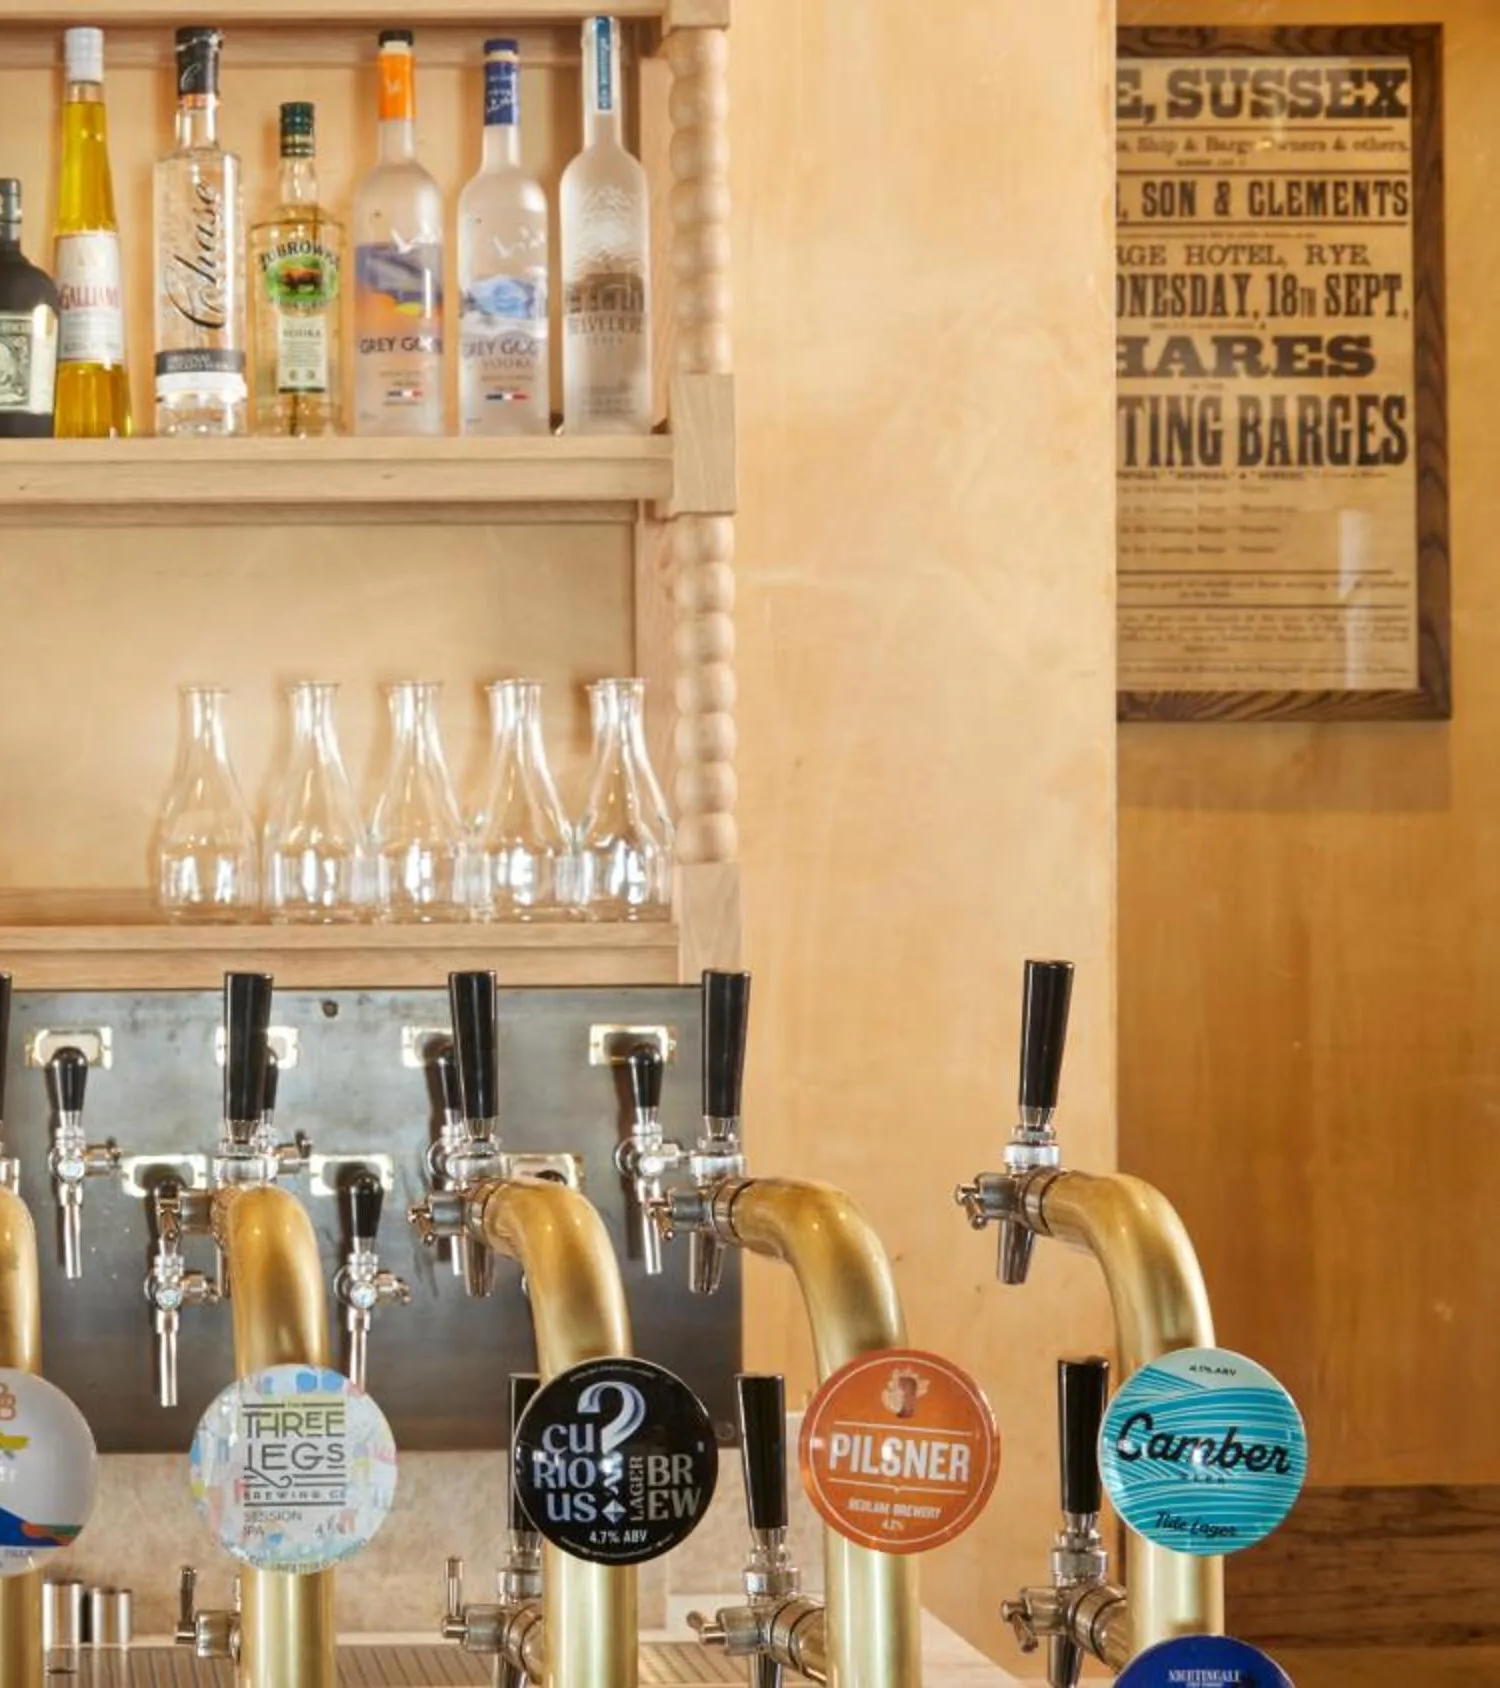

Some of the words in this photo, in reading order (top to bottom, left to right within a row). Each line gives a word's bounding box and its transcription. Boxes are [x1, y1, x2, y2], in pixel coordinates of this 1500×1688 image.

[1167, 68, 1408, 120] SUSSEX
[1142, 180, 1197, 218] SON
[1214, 180, 1232, 218] &
[1248, 180, 1409, 218] CLEMENTS
[164, 181, 227, 331] Chase
[1117, 394, 1223, 467] TING
[1237, 394, 1409, 467] BARGES
[243, 1411, 346, 1439] THREE
[1117, 1412, 1291, 1474] Camber
[243, 1442, 346, 1482] LEGS
[829, 1432, 971, 1483] PILSNER
[629, 1455, 645, 1522] LAGER
[892, 1502, 942, 1520] BREWERY
[589, 1529, 621, 1544] 4.7%
[623, 1529, 648, 1544] ABV
